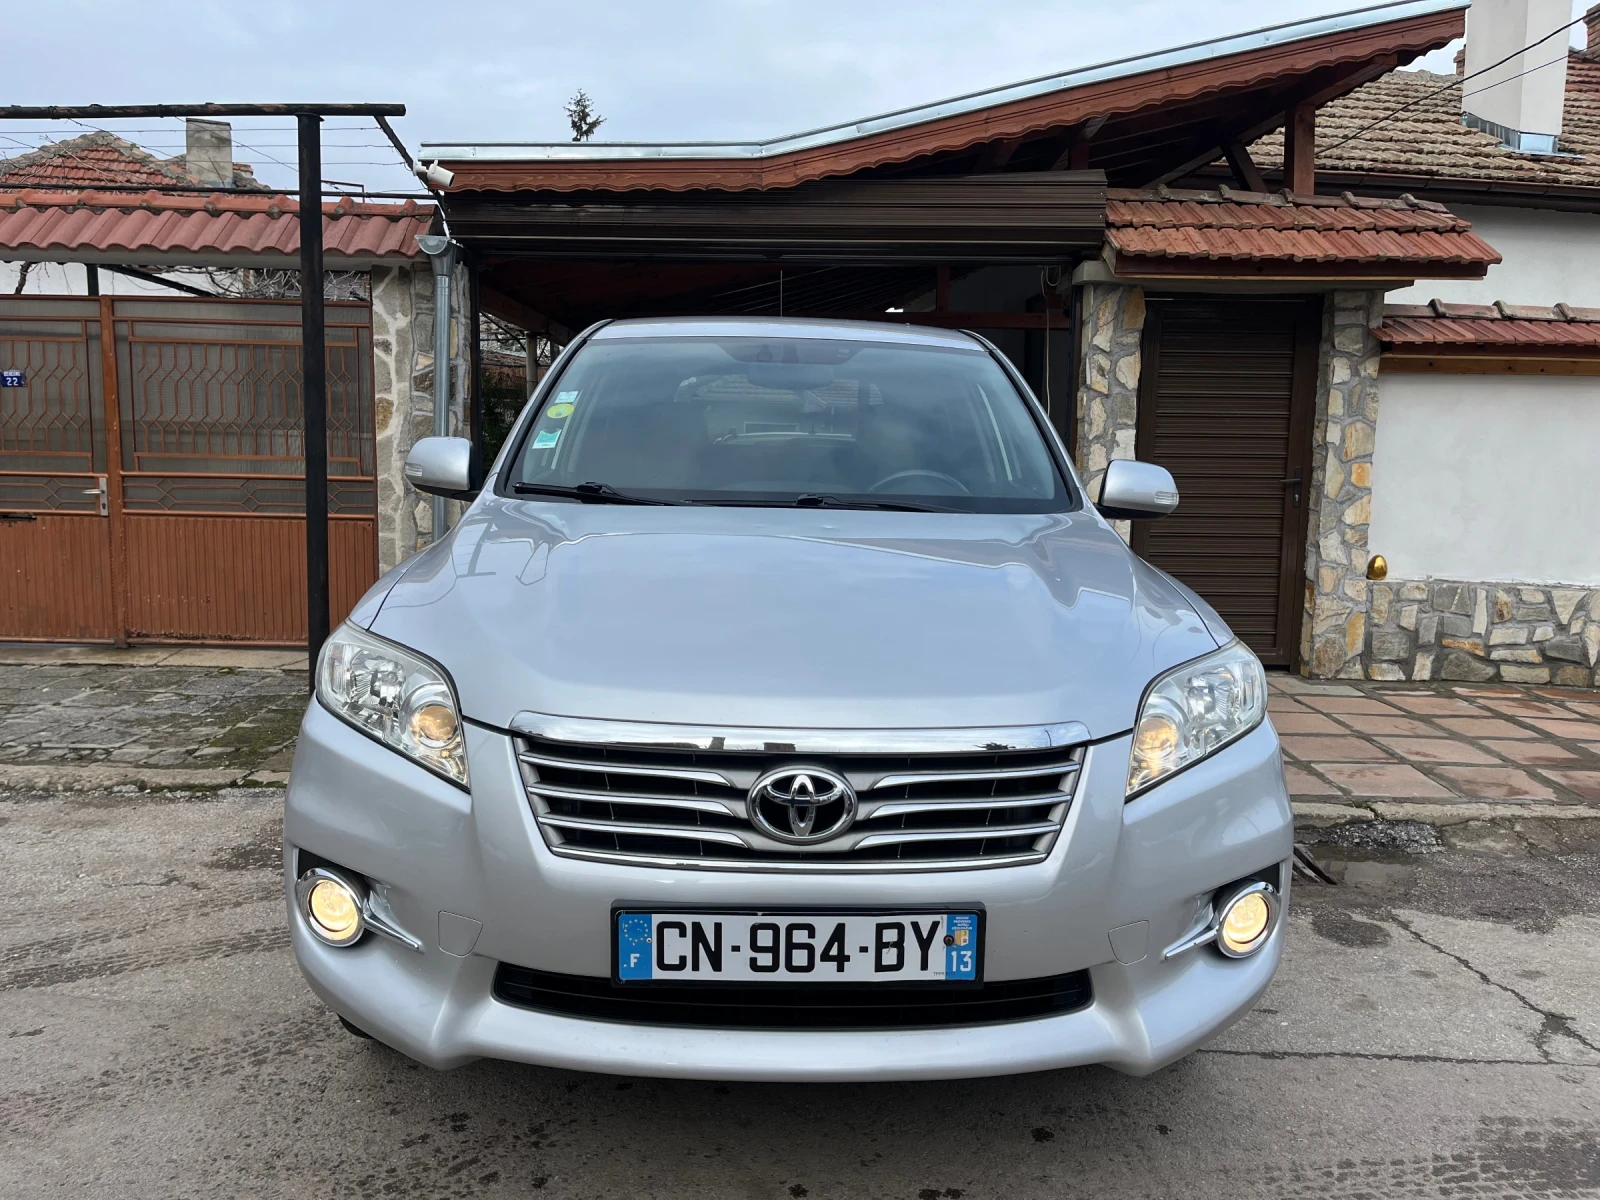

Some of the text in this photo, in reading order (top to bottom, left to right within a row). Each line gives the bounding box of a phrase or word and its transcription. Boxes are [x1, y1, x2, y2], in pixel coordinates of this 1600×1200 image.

[6, 377, 19, 386] 22
[656, 920, 941, 973] CN-964-BY
[630, 953, 640, 968] F
[951, 950, 972, 972] 13
